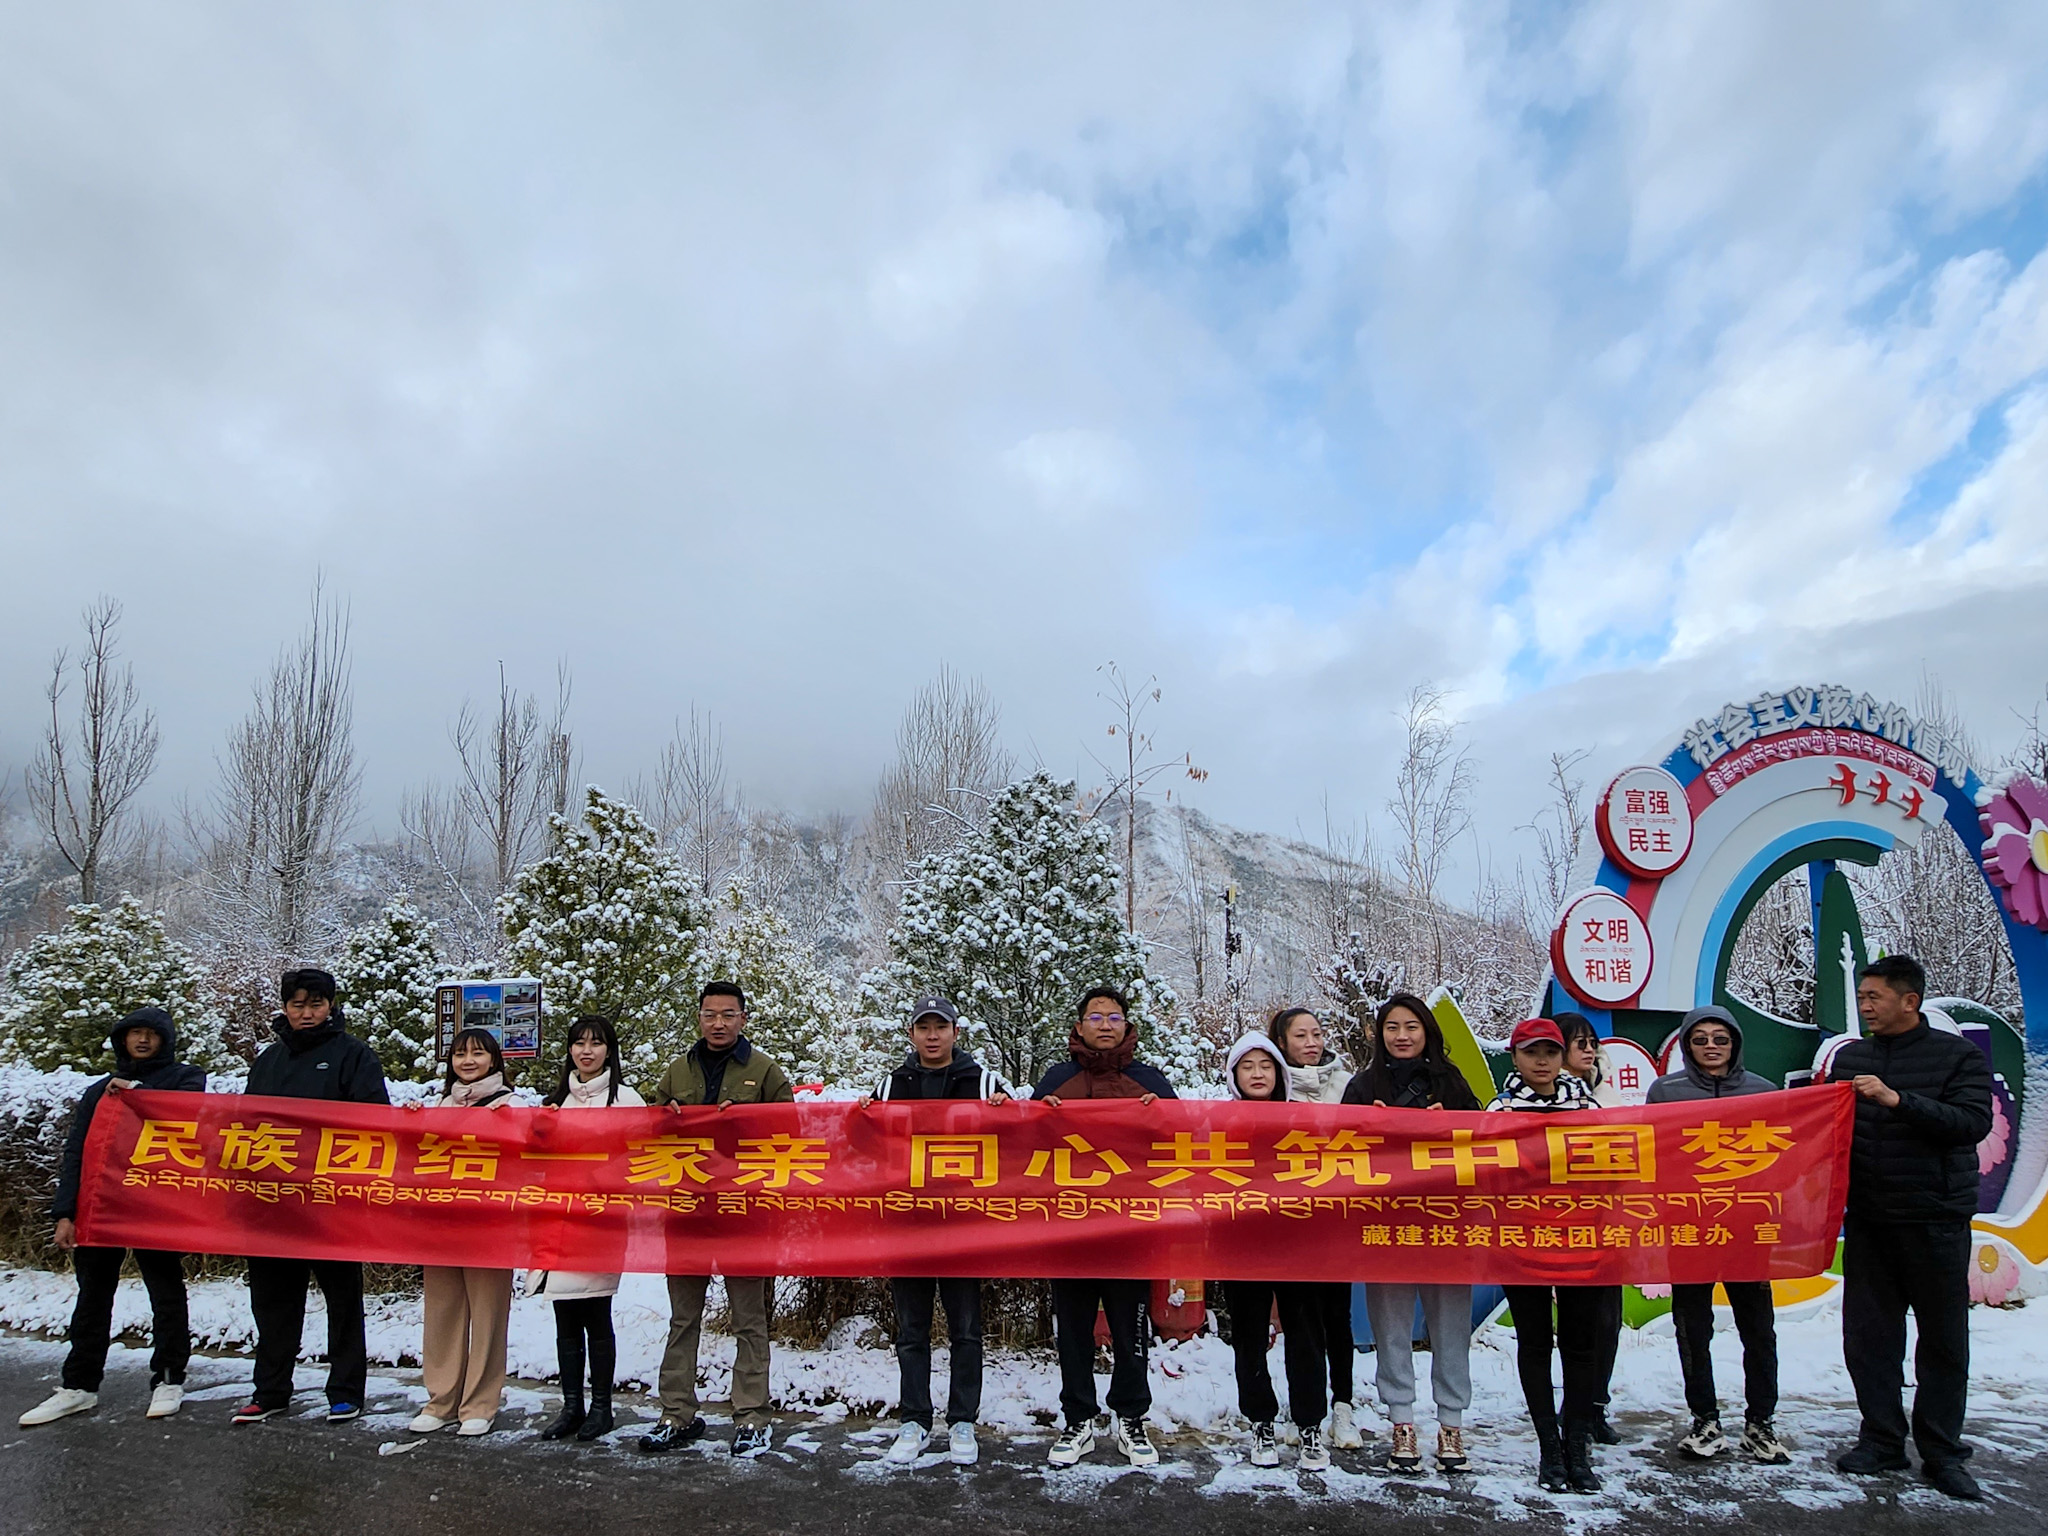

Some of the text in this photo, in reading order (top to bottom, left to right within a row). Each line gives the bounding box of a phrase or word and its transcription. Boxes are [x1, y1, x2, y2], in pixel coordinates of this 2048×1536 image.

[1686, 684, 1969, 789] 社会主义核心价值观
[1625, 789, 1670, 815] 富强
[1629, 828, 1673, 853] 民主
[1582, 918, 1629, 943] 文明
[1585, 958, 1632, 984] 和谐
[129, 1119, 1797, 1188] 民族团结一家亲 同心共筑中国梦
[1361, 1222, 1782, 1249] 藏建投资民族团结创建办 宣
